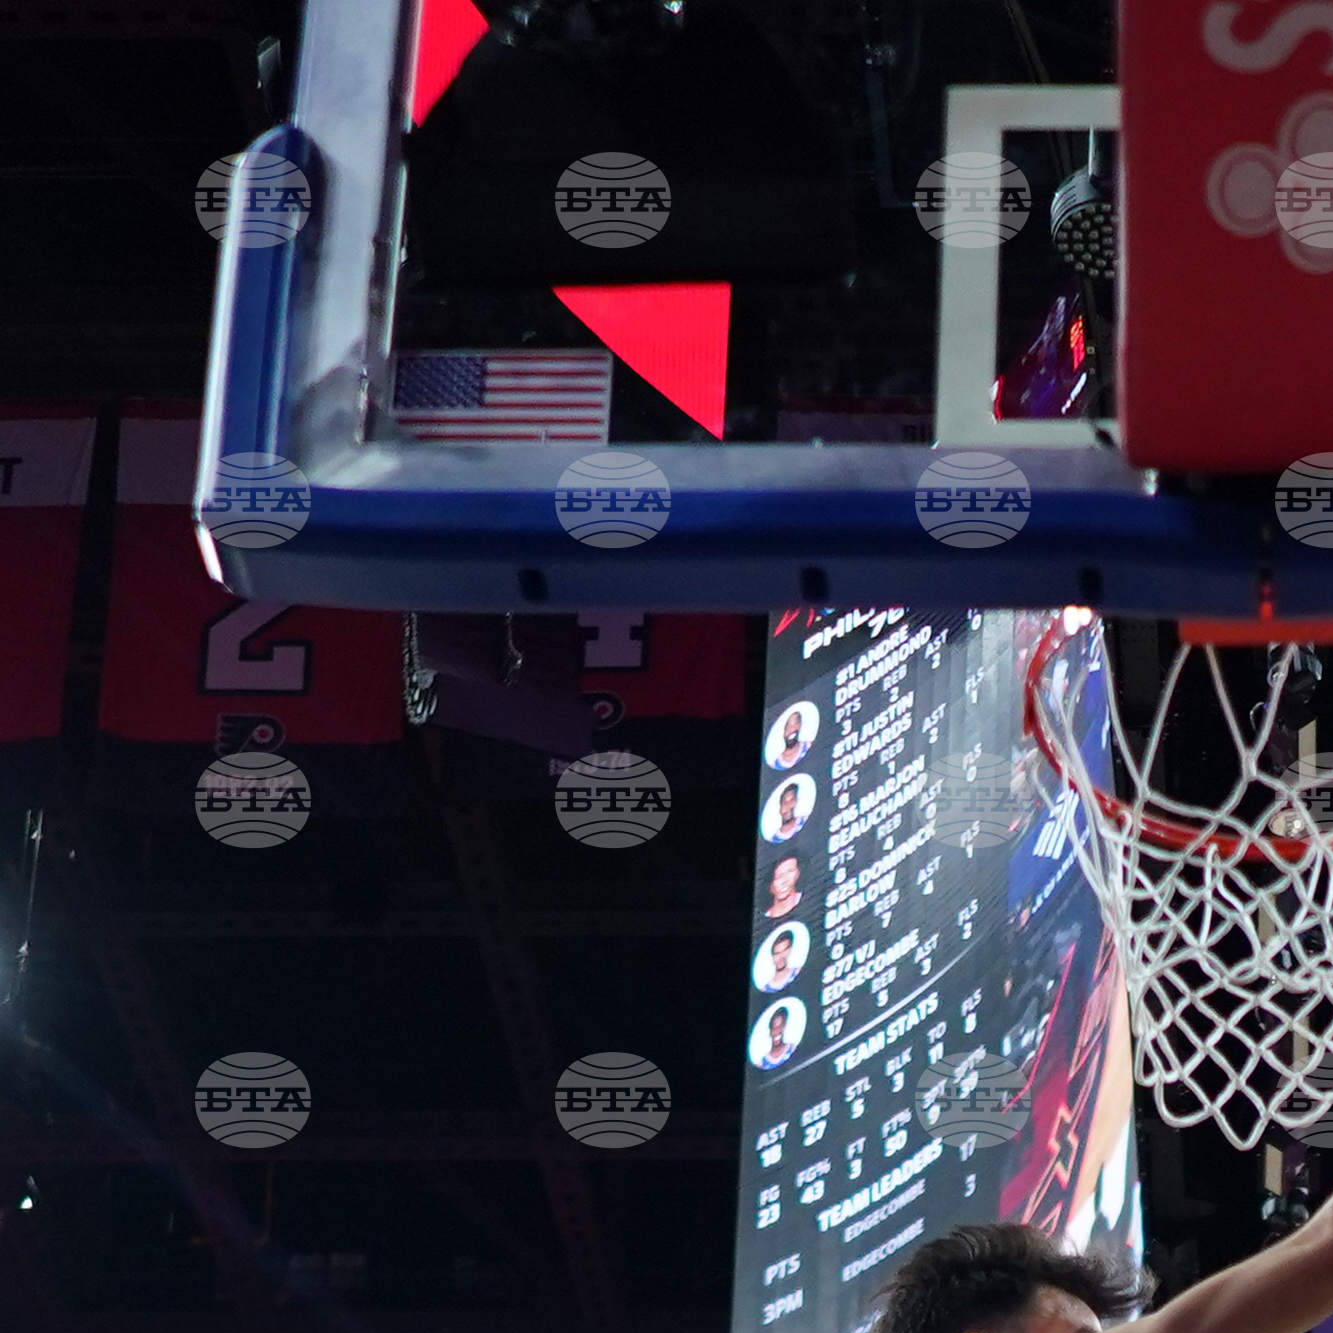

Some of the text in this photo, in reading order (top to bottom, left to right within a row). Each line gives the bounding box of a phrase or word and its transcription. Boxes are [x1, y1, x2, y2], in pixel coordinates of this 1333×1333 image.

[835, 625, 932, 707] DRUMMOND
[836, 628, 949, 723] PTS REB AST
[856, 624, 909, 674] ANDRE
[831, 712, 912, 779] EDWARDS
[832, 666, 984, 797] PTS REB AST FLS
[860, 691, 914, 742] JUSTIN
[828, 772, 928, 854] BEAUCHAMP
[859, 754, 925, 814] MARJON
[829, 778, 945, 871] PTS REB AST
[858, 819, 936, 889] DOMINICK
[825, 869, 897, 929] BARLOW
[826, 920, 853, 947] PTS
[874, 889, 899, 917] REB
[916, 855, 942, 886] AST
[821, 928, 920, 1006] EDGECOMBE
[822, 898, 978, 1024] PTS REB AST FLS
[853, 939, 876, 963] VJ
[800, 987, 982, 1127] REB STL BLK TO FLS
[834, 991, 939, 1075] TEAM STATS
[756, 1121, 789, 1151] AST
[758, 1137, 866, 1207] FG FT
[803, 1120, 827, 1146] 27
[757, 1203, 781, 1229] 23
[817, 1137, 944, 1232] TEAM LEADERS
[761, 1217, 926, 1325] 3PM EDGECOMBE
[763, 1178, 926, 1287] PTS EDGECOMBE
